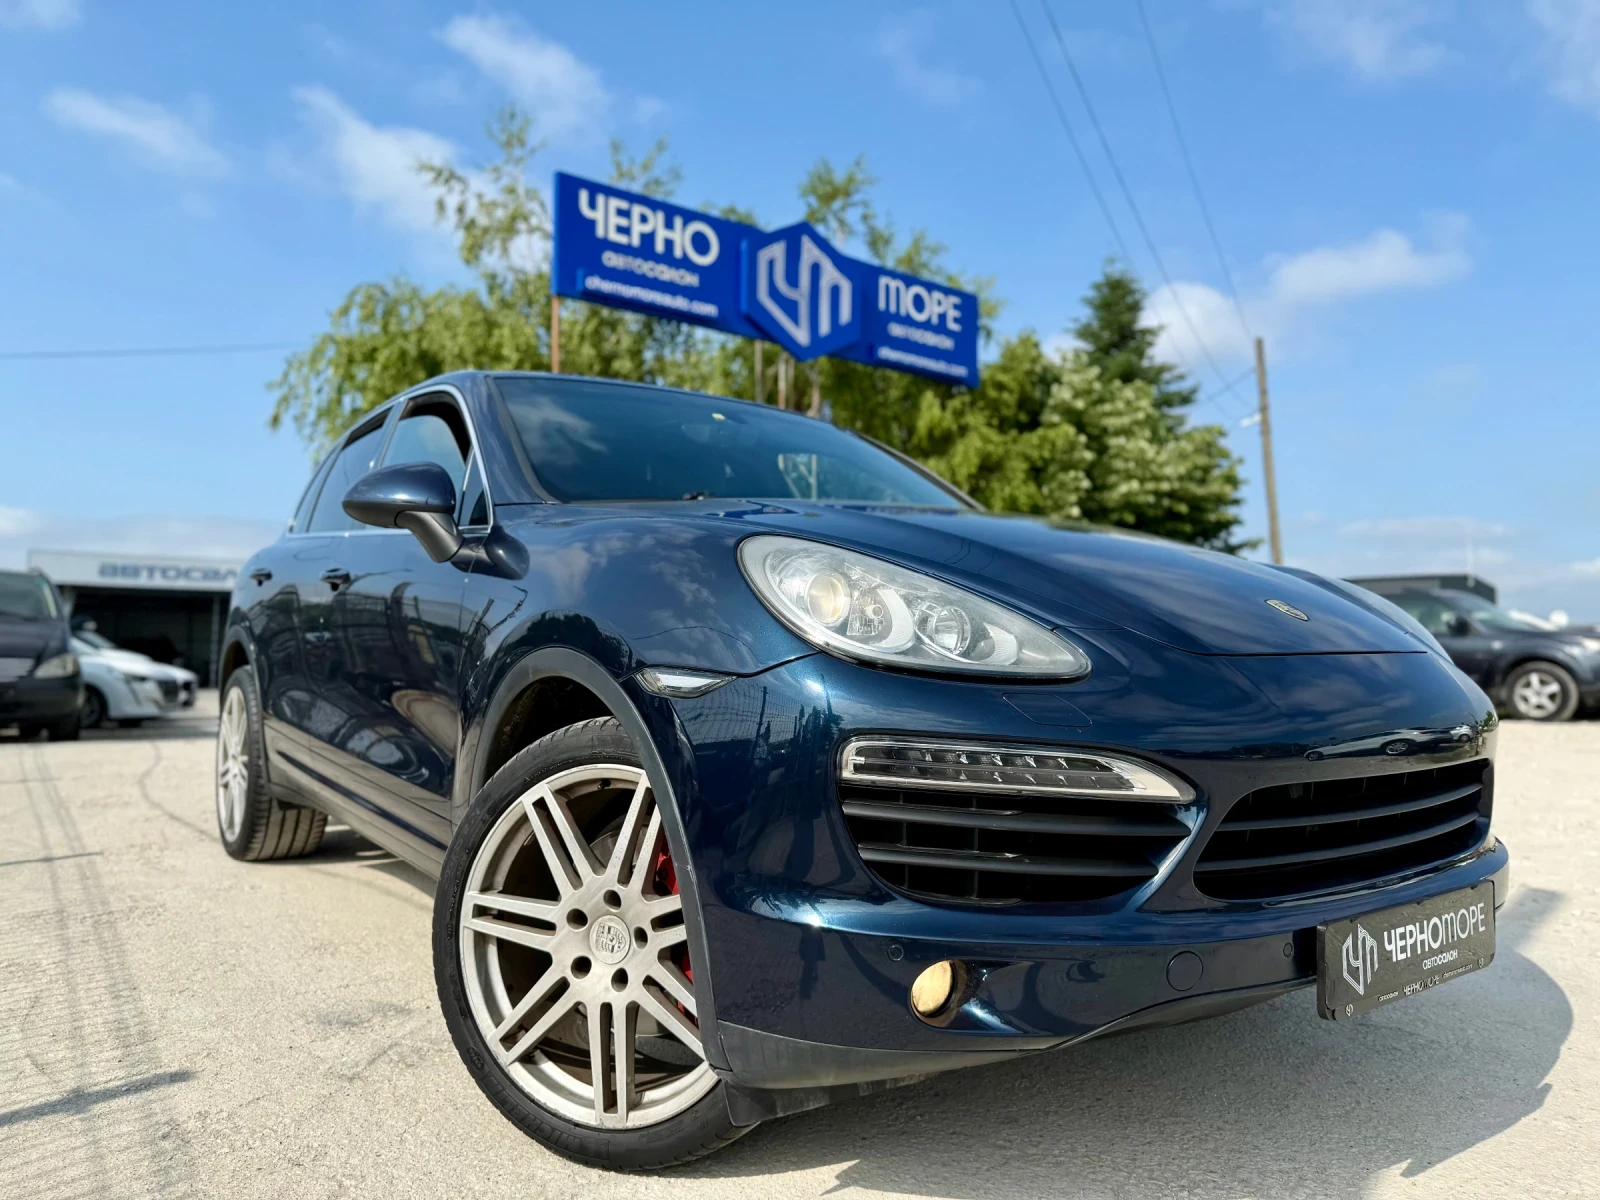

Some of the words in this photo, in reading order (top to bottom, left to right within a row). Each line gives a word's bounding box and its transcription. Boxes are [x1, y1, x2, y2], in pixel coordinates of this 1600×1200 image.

[578, 188, 720, 267] ЧЕРНО
[877, 274, 963, 332] МОРЕ
[1383, 902, 1486, 963] ЧЕРНОМОРЕ
[1422, 949, 1459, 970] автосалон
